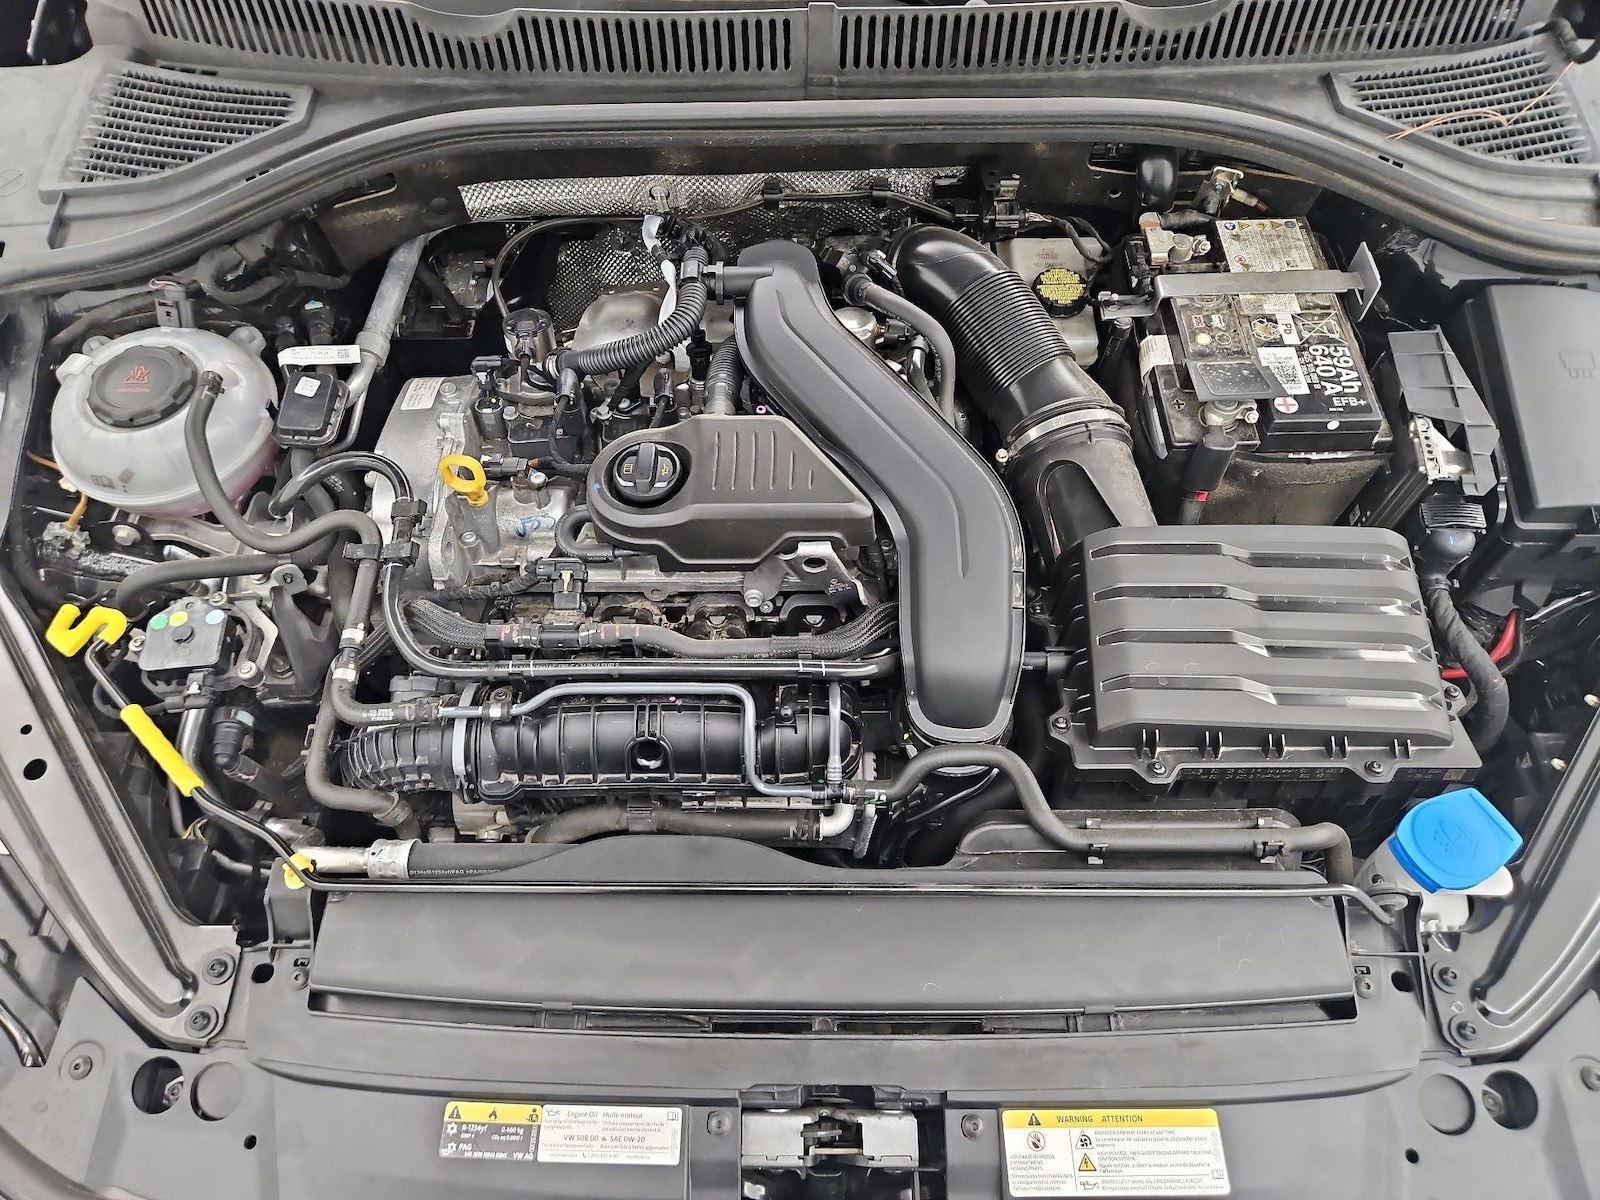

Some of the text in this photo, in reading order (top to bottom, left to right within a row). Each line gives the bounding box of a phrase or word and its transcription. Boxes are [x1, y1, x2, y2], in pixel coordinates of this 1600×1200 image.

[1282, 323, 1292, 335] Pb
[1309, 345, 1337, 377] 640
[1330, 346, 1362, 393] 59Ah
[1320, 381, 1343, 396] A
[1332, 396, 1367, 406] EFB+
[567, 1110, 588, 1119] Engine
[1056, 1115, 1144, 1123] WARNING ATTENTION
[462, 1124, 488, 1133] R-1234yf
[458, 1143, 473, 1151] PAG
